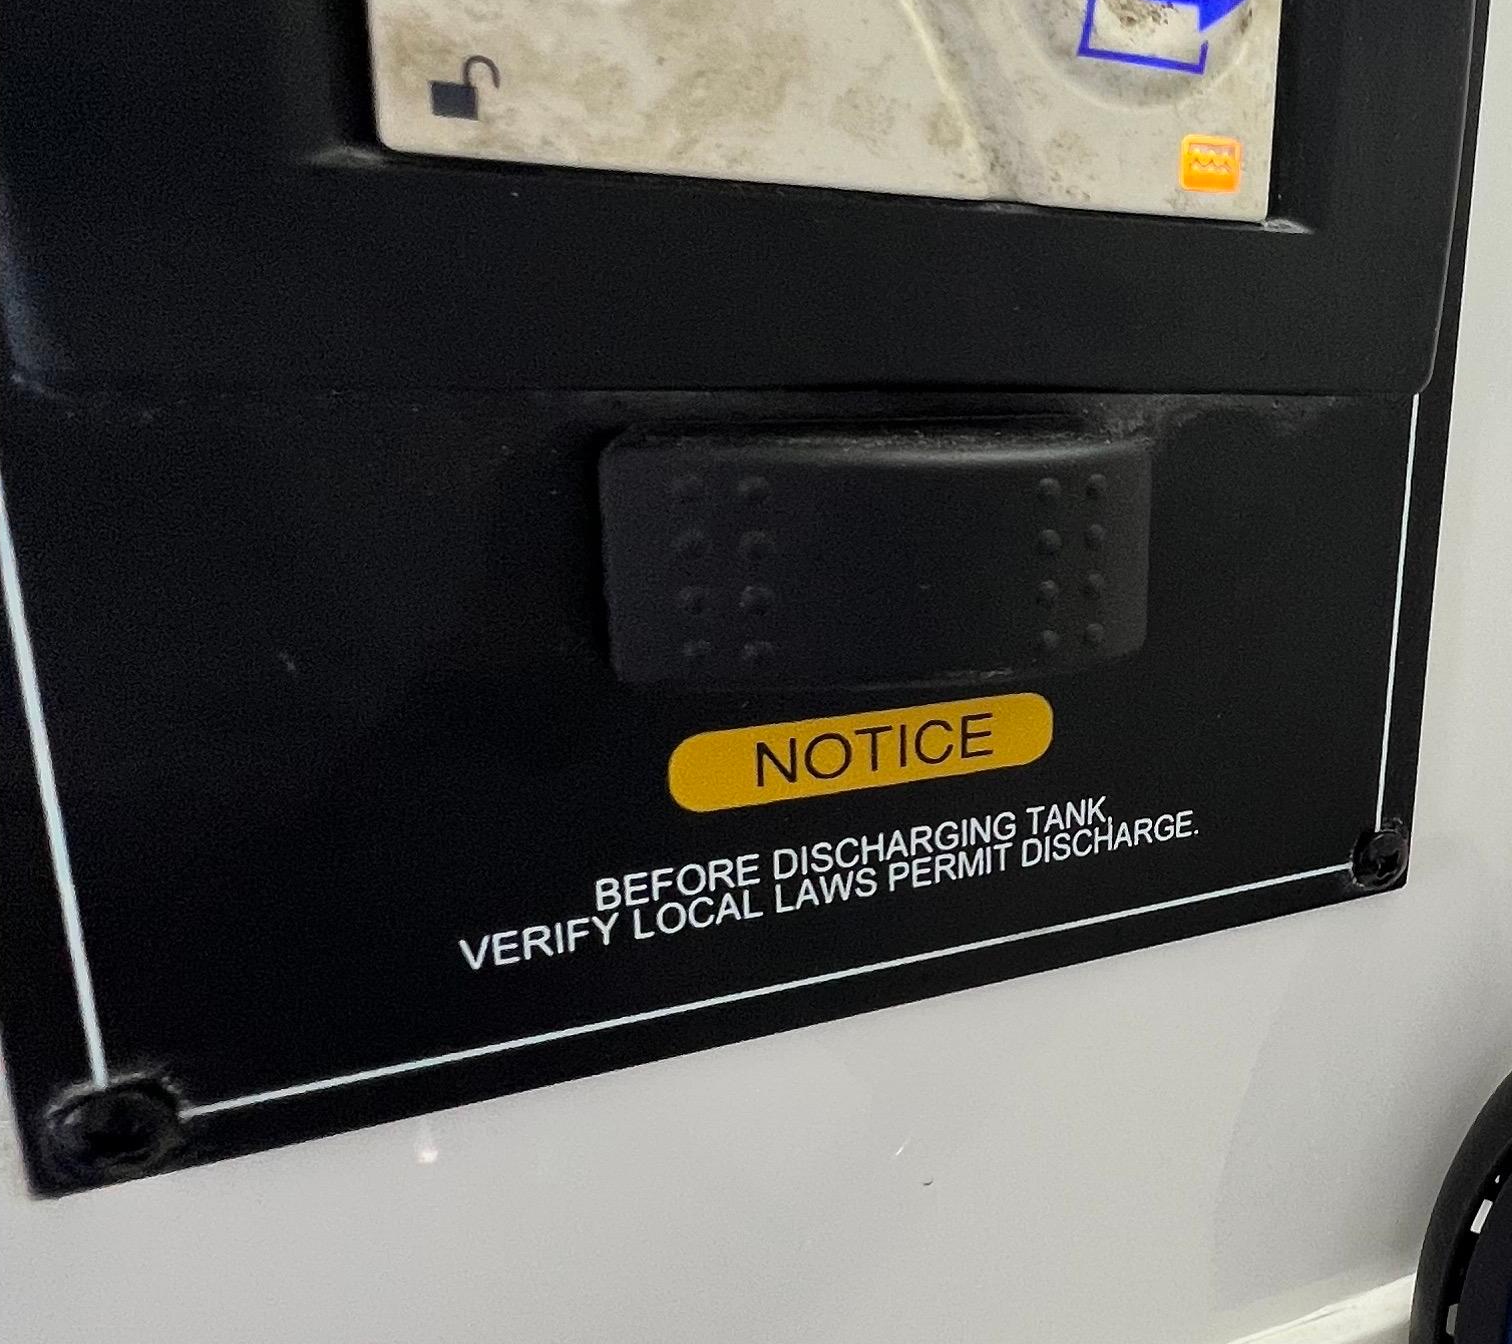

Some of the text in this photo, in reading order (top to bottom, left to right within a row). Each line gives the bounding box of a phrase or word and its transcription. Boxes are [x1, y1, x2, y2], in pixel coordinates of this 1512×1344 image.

[755, 712, 994, 787] NOTICE
[458, 809, 1200, 970] VERIFY LOCAL LAWS PERMIT DISCHARGE.
[595, 795, 1114, 911] BEFORE DISCHARGING TANK,
